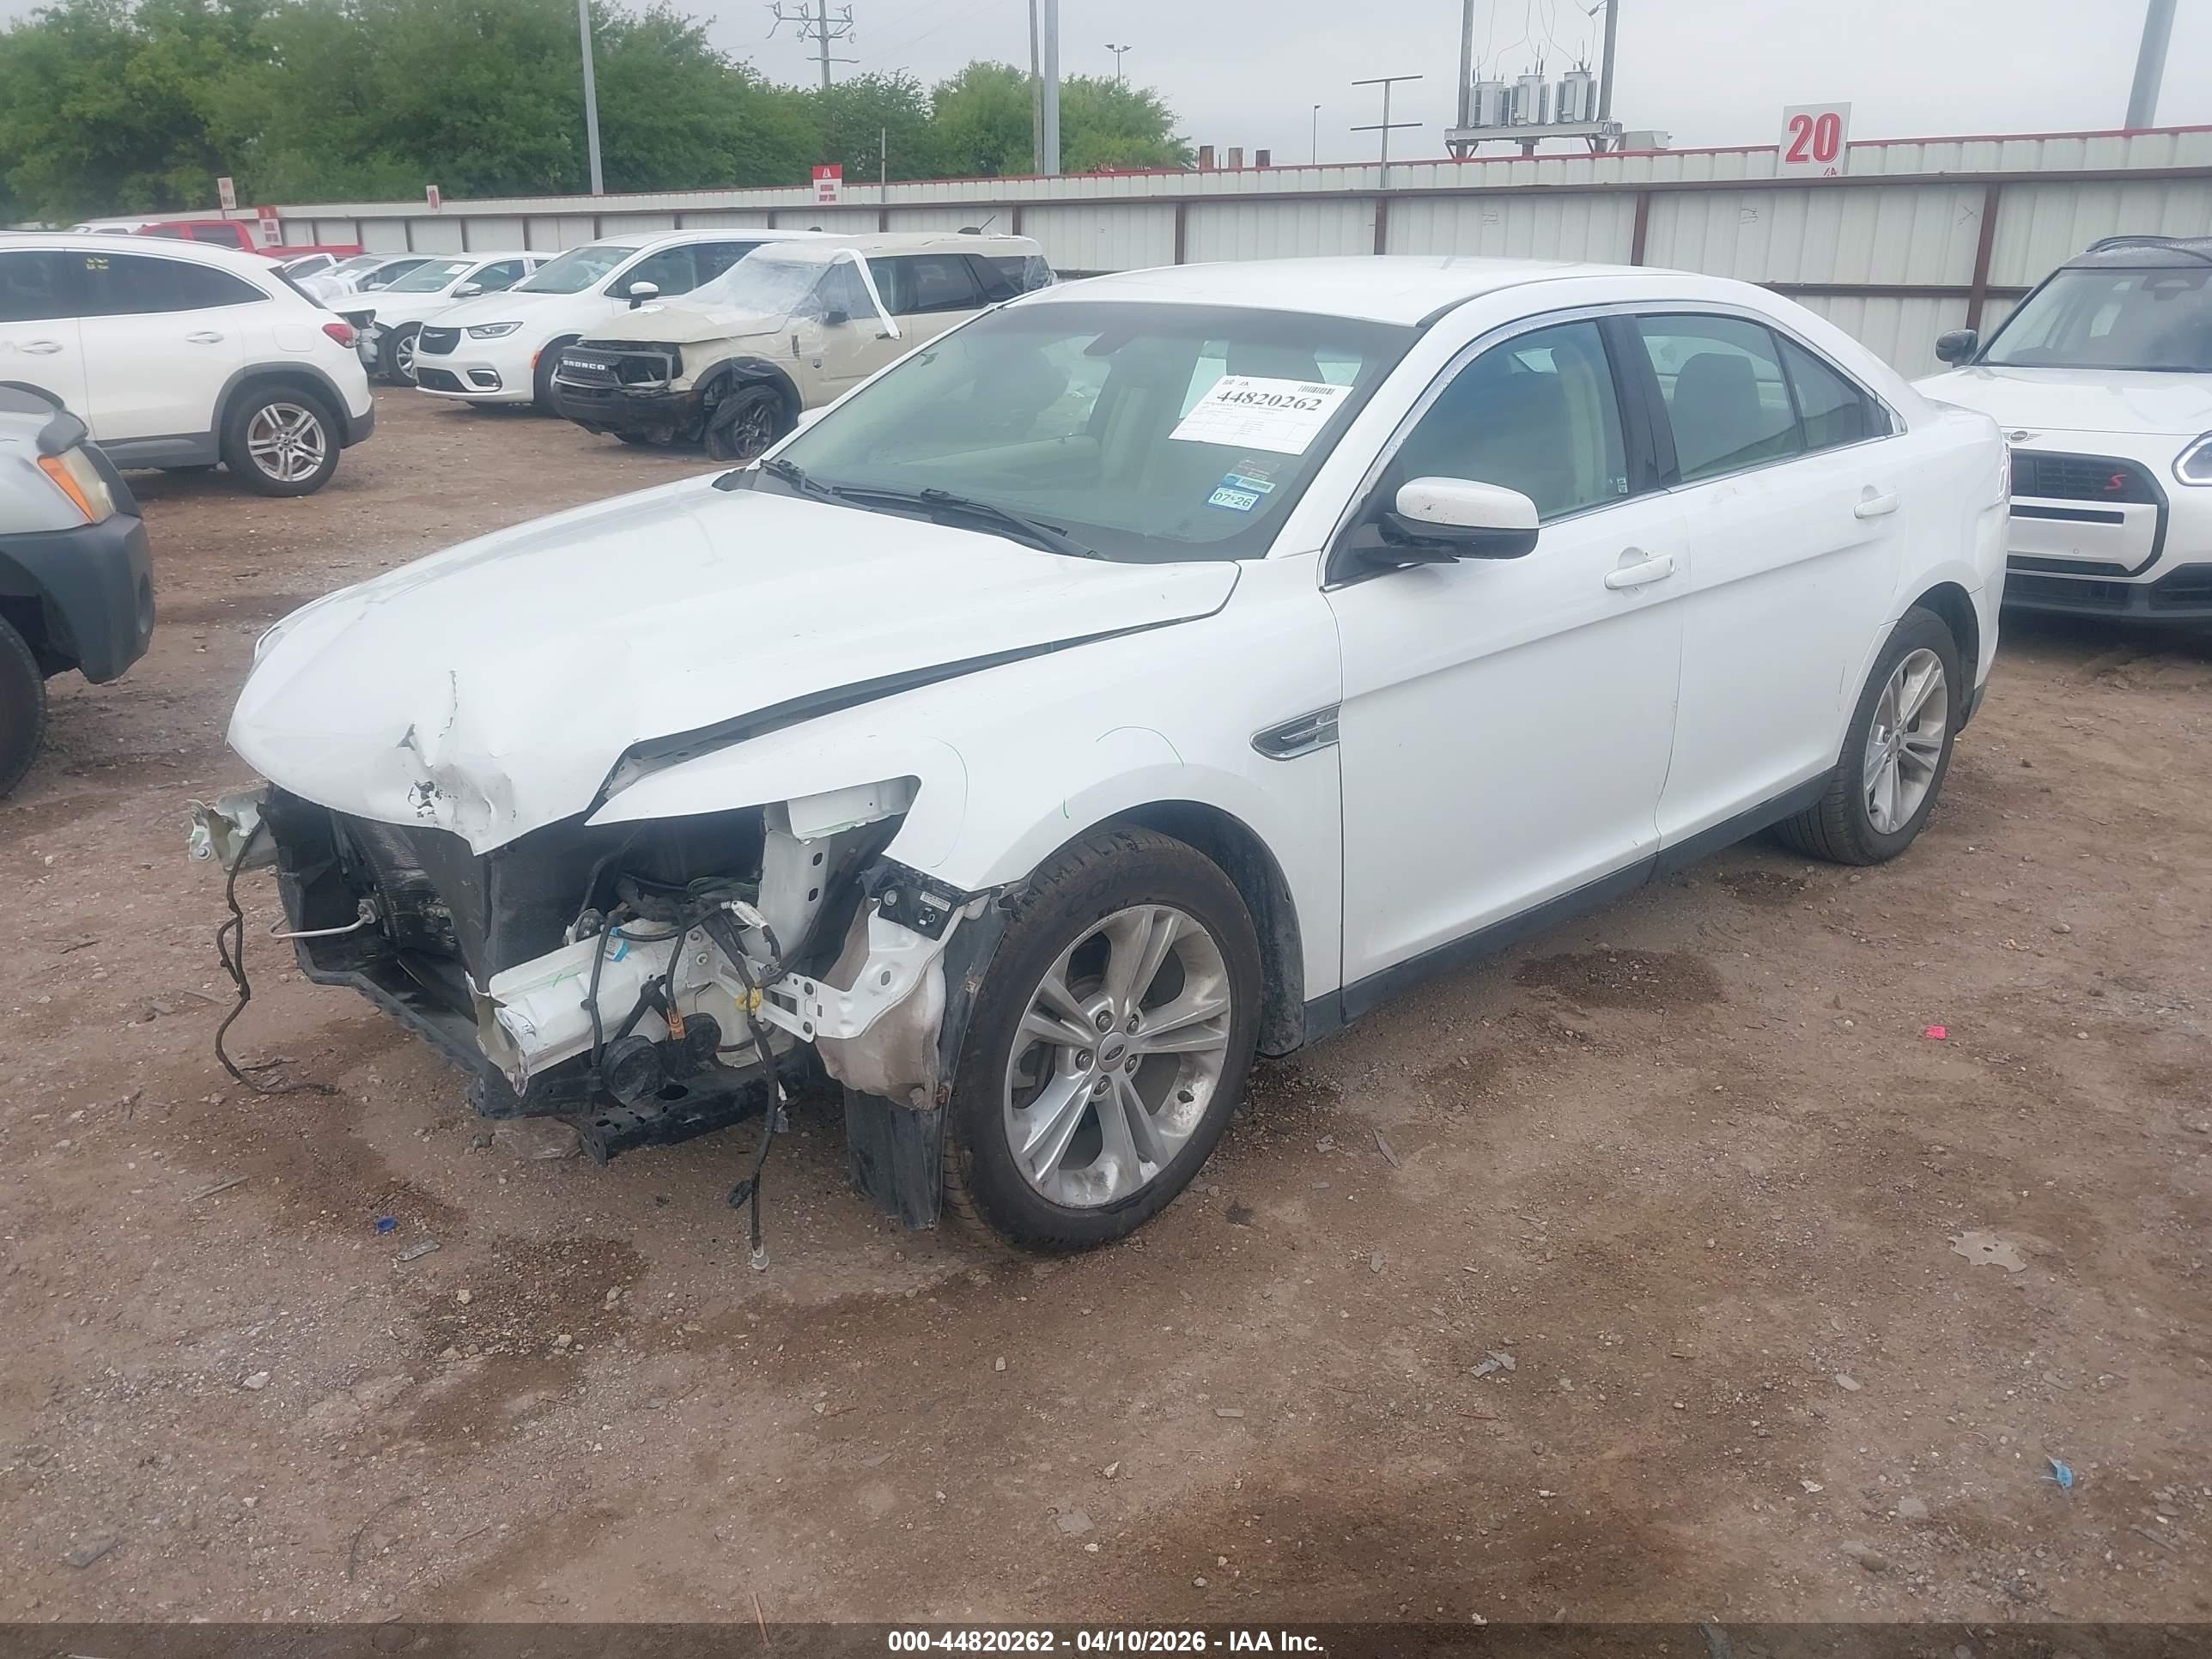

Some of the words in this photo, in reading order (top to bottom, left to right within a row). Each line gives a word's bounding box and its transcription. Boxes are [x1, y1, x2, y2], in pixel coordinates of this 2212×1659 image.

[1785, 112, 1842, 164] 20
[562, 360, 605, 371] BRONCO
[1217, 391, 1322, 411] 44820262
[2103, 474, 2128, 490] S
